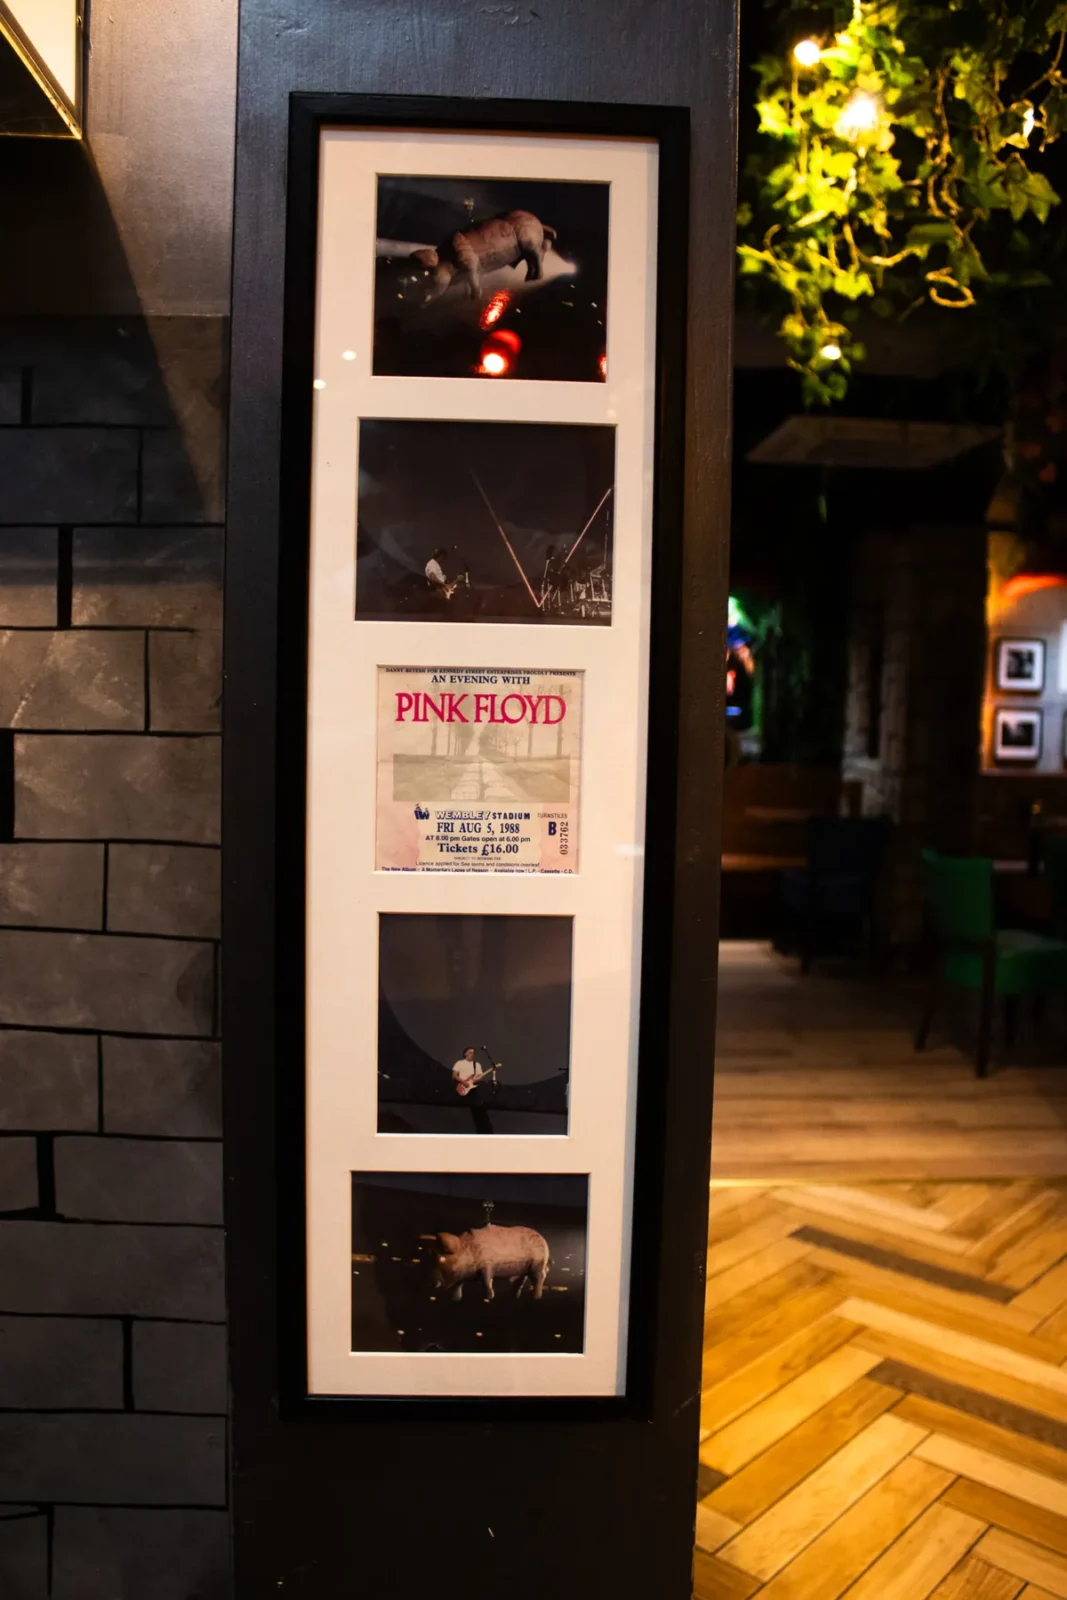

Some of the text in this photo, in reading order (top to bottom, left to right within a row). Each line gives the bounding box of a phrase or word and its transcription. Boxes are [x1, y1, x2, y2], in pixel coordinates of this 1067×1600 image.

[431, 675, 530, 684] AN EVENING WITH
[395, 692, 566, 724] PINK FLOYD
[435, 810, 491, 820] WEMBLEY
[436, 822, 520, 835] FRI AUG 5, 1988
[548, 822, 557, 836] B
[560, 821, 569, 855] 033762
[438, 843, 519, 856] Tickets £16.00
